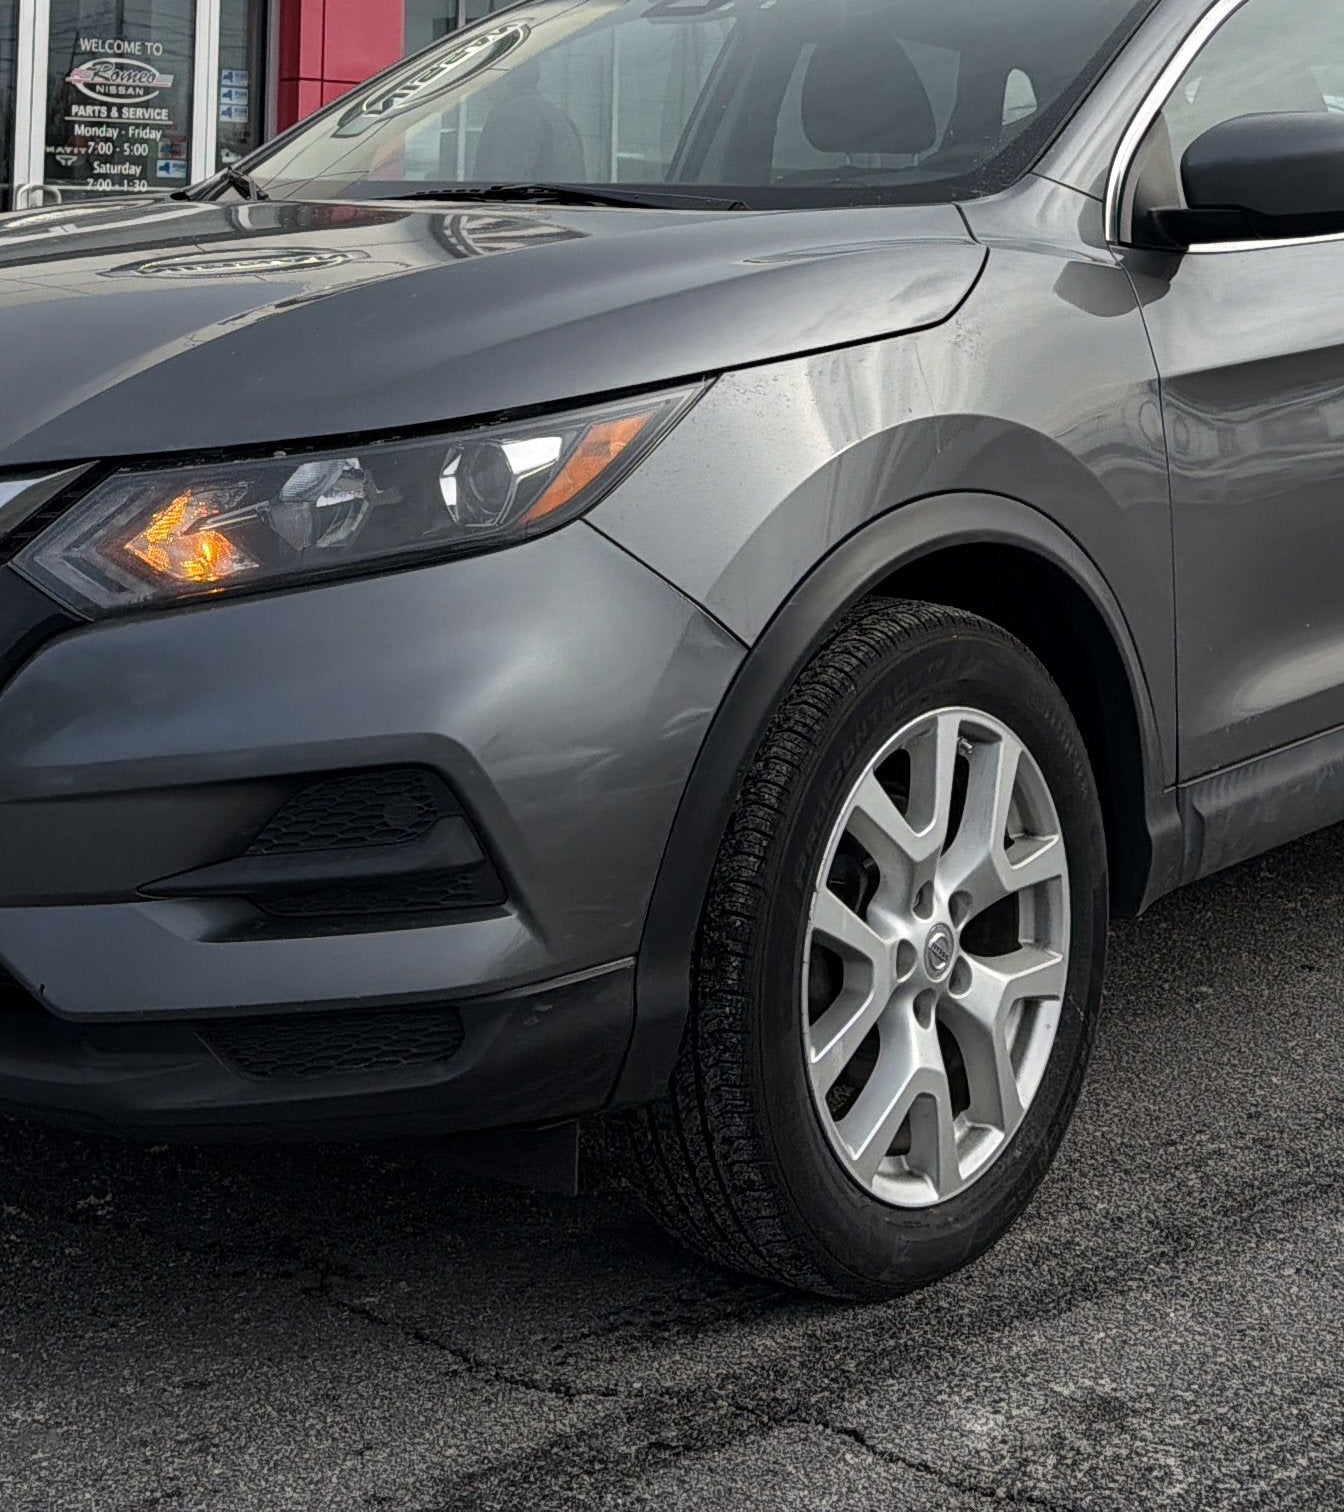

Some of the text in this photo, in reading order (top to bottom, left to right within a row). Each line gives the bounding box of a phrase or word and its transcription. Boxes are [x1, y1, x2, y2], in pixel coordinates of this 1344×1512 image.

[79, 38, 163, 56] WELCOME TO
[91, 61, 156, 84] Romeo
[95, 85, 144, 95] NISSAN
[71, 105, 169, 120] PARTS & SERVICE
[74, 124, 119, 140] Monday
[128, 126, 162, 142] Friday
[87, 141, 113, 155] 7:00
[123, 143, 149, 156] 5:00
[93, 160, 142, 177] Saturday
[87, 178, 113, 191] 7:00
[123, 179, 148, 192] 1:30
